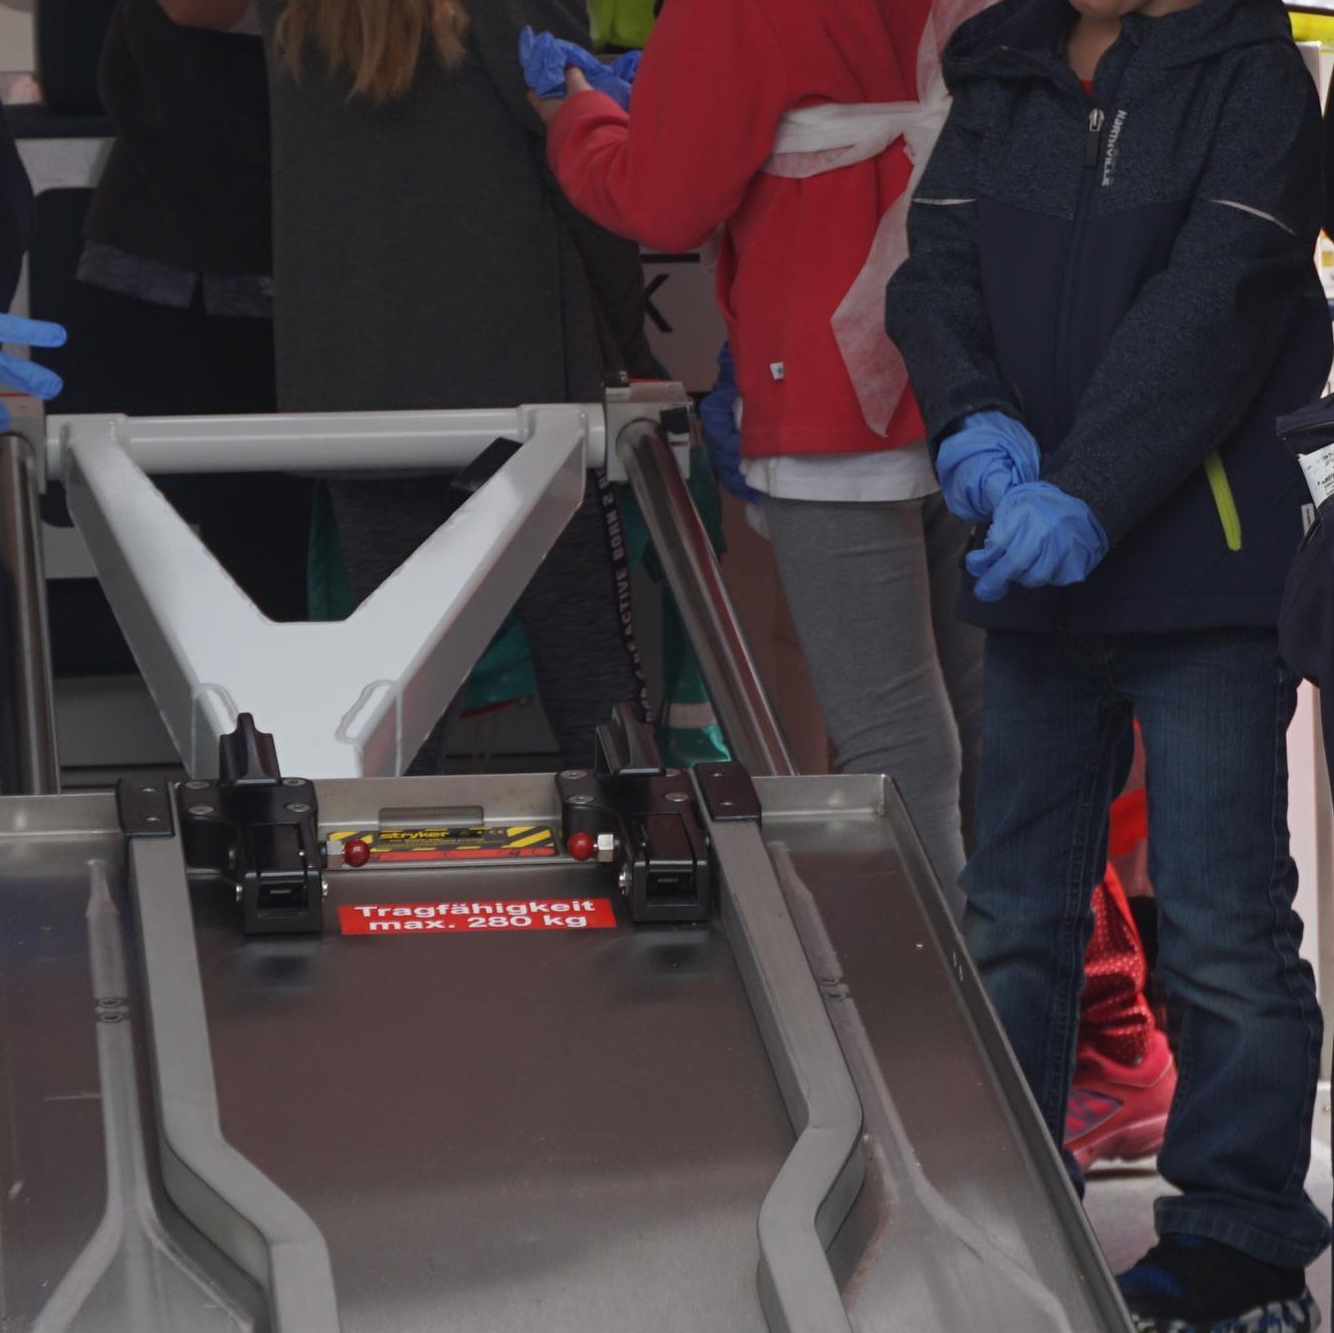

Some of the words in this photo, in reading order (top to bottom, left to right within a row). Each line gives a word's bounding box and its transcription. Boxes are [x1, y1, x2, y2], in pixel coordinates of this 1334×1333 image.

[378, 830, 450, 840] stryker
[354, 899, 596, 918] Tragfähigkeit
[368, 919, 456, 932] max.
[467, 915, 533, 929] 280
[543, 914, 588, 928] kg
